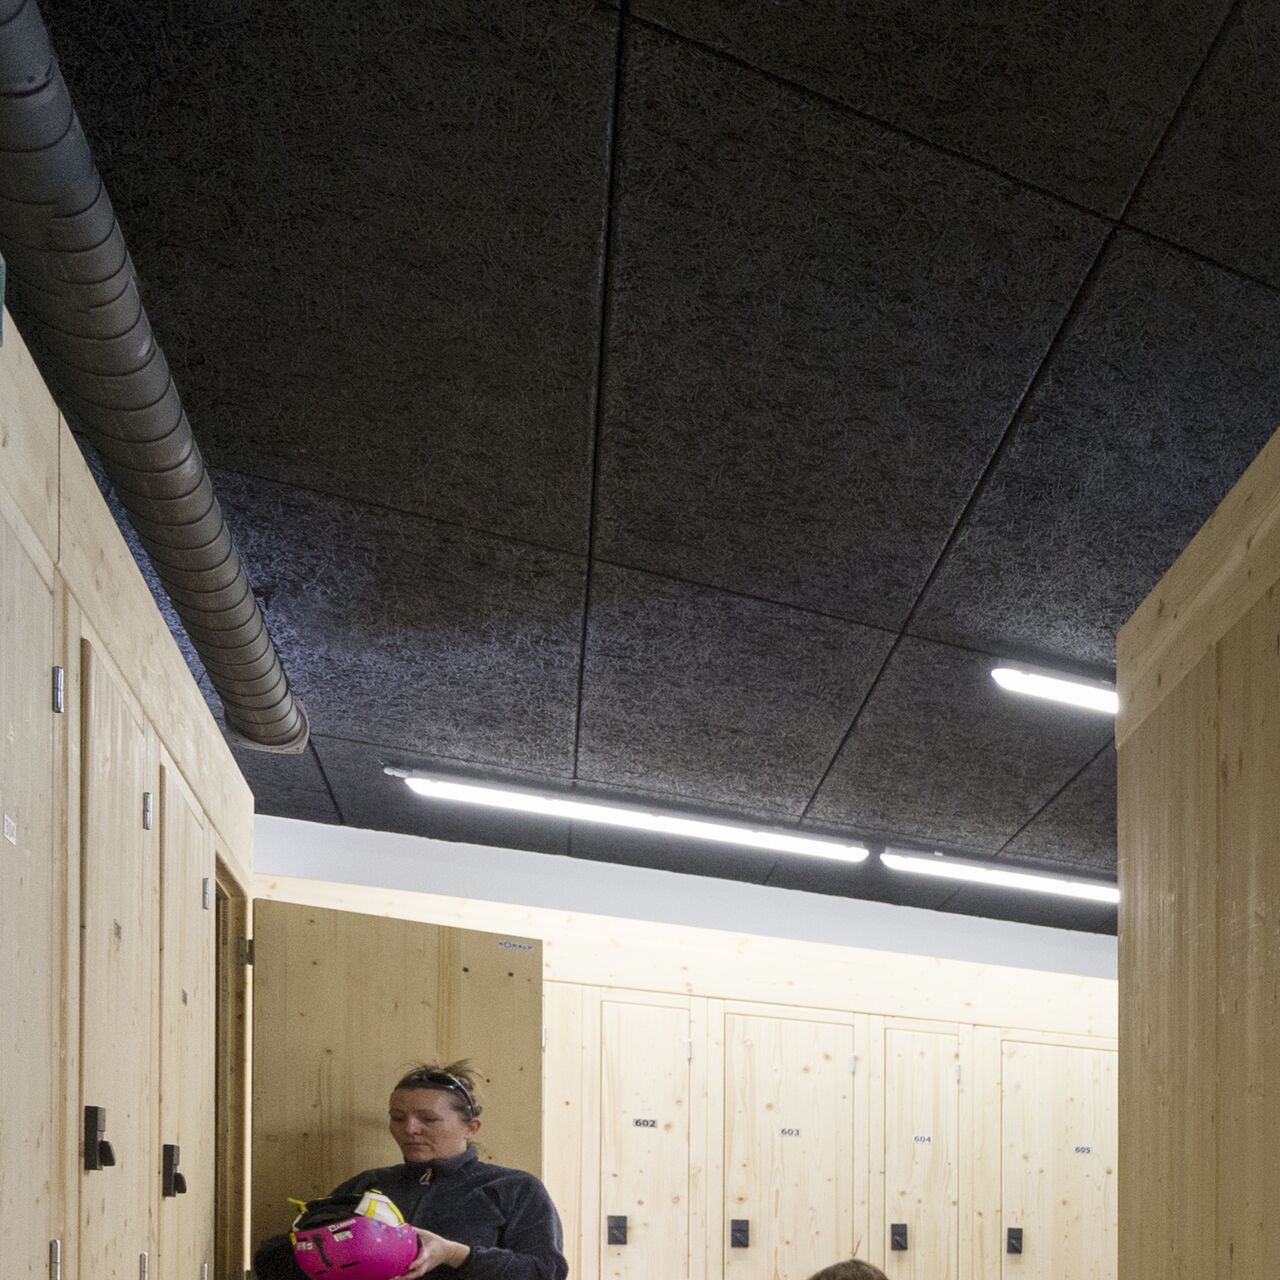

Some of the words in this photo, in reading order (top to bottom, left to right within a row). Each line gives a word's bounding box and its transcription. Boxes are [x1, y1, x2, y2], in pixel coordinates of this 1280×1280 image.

[635, 1119, 656, 1128] 602
[781, 1128, 800, 1136] 603
[913, 1135, 932, 1143] 604
[1074, 1146, 1091, 1154] 605
